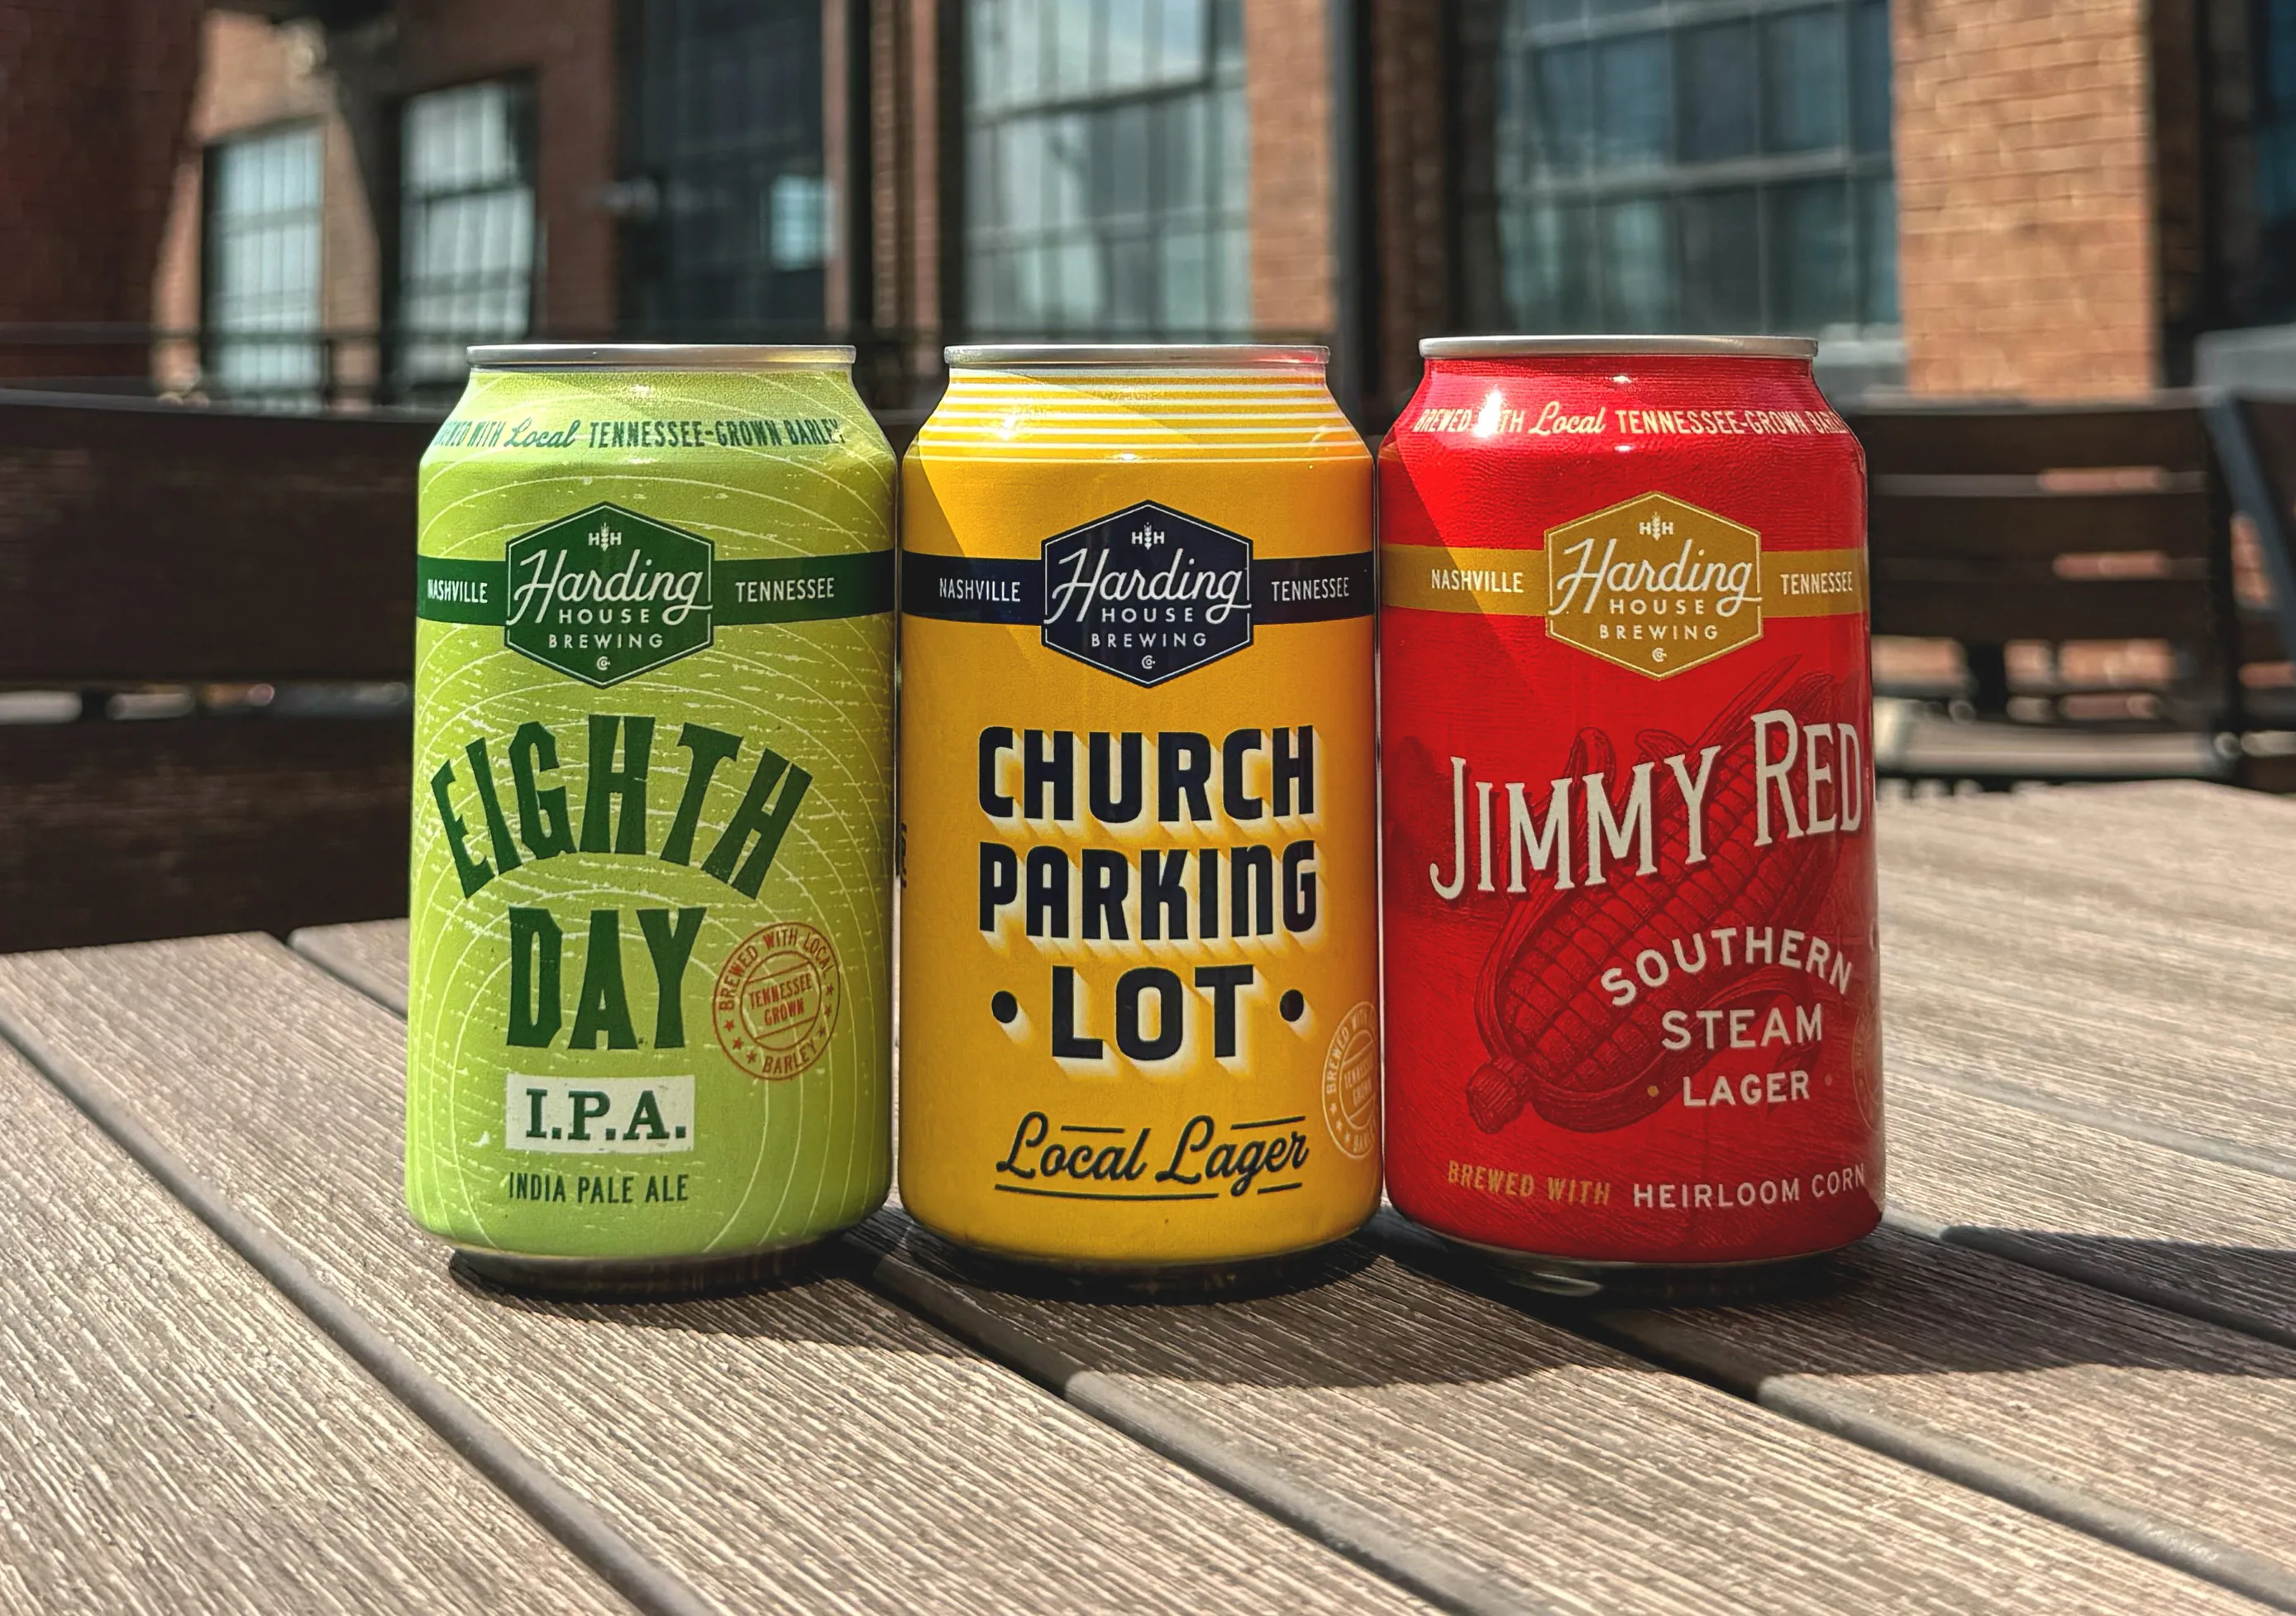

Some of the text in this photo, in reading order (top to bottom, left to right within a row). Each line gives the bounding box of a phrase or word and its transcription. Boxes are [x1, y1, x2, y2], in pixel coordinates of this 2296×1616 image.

[466, 421, 507, 447] WITH
[504, 416, 580, 447] Local
[589, 419, 783, 447] TENNESSEE-GROWN
[783, 418, 846, 445] BARLEY
[1412, 408, 1472, 433] BREWED
[1528, 401, 1606, 436] Local
[1615, 409, 1811, 434] TENNESSEE-GROWN
[427, 579, 488, 604] NASHVILLE
[506, 548, 714, 625] Harding
[736, 576, 835, 603] TENNESSEE
[939, 577, 1021, 603] NASHVILLE
[1043, 547, 1252, 624] Harding
[1272, 576, 1350, 602] TENNESSEE
[1431, 568, 1524, 594] NASHVILLE
[1548, 538, 1763, 617] Harding
[1780, 571, 1853, 595] TENNESSEE
[559, 608, 650, 624] HOUSE
[1101, 607, 1194, 623] HOUSE
[1609, 599, 1704, 614] HOUSE
[548, 633, 662, 648] BREWING
[1091, 633, 1207, 648] BREWING
[1599, 624, 1718, 640] BREWING
[979, 724, 1315, 824] CHURCH
[431, 714, 813, 900] EIGHTH
[1430, 709, 1864, 900] JIMMY RED
[506, 906, 708, 1050] DAY
[719, 927, 835, 1011] BREWED WITH LOCAL
[1601, 926, 1852, 1006] SOUTHERN
[748, 973, 814, 1010] TENNESSEE
[764, 997, 804, 1026] GROWN
[1053, 964, 1254, 1061] LOT
[1661, 1003, 1822, 1050] STEAM
[762, 1038, 818, 1075] BARLEY
[1326, 1026, 1349, 1095] BREWED
[1683, 1070, 1811, 1107] LAGER
[526, 1087, 687, 1142] I.P.A.
[996, 1111, 1310, 1197] Local Lager
[508, 1171, 689, 1204] INDIA PALE ALE
[1448, 1160, 1865, 1210] BREWED WITH HEIRLOOM CORN
